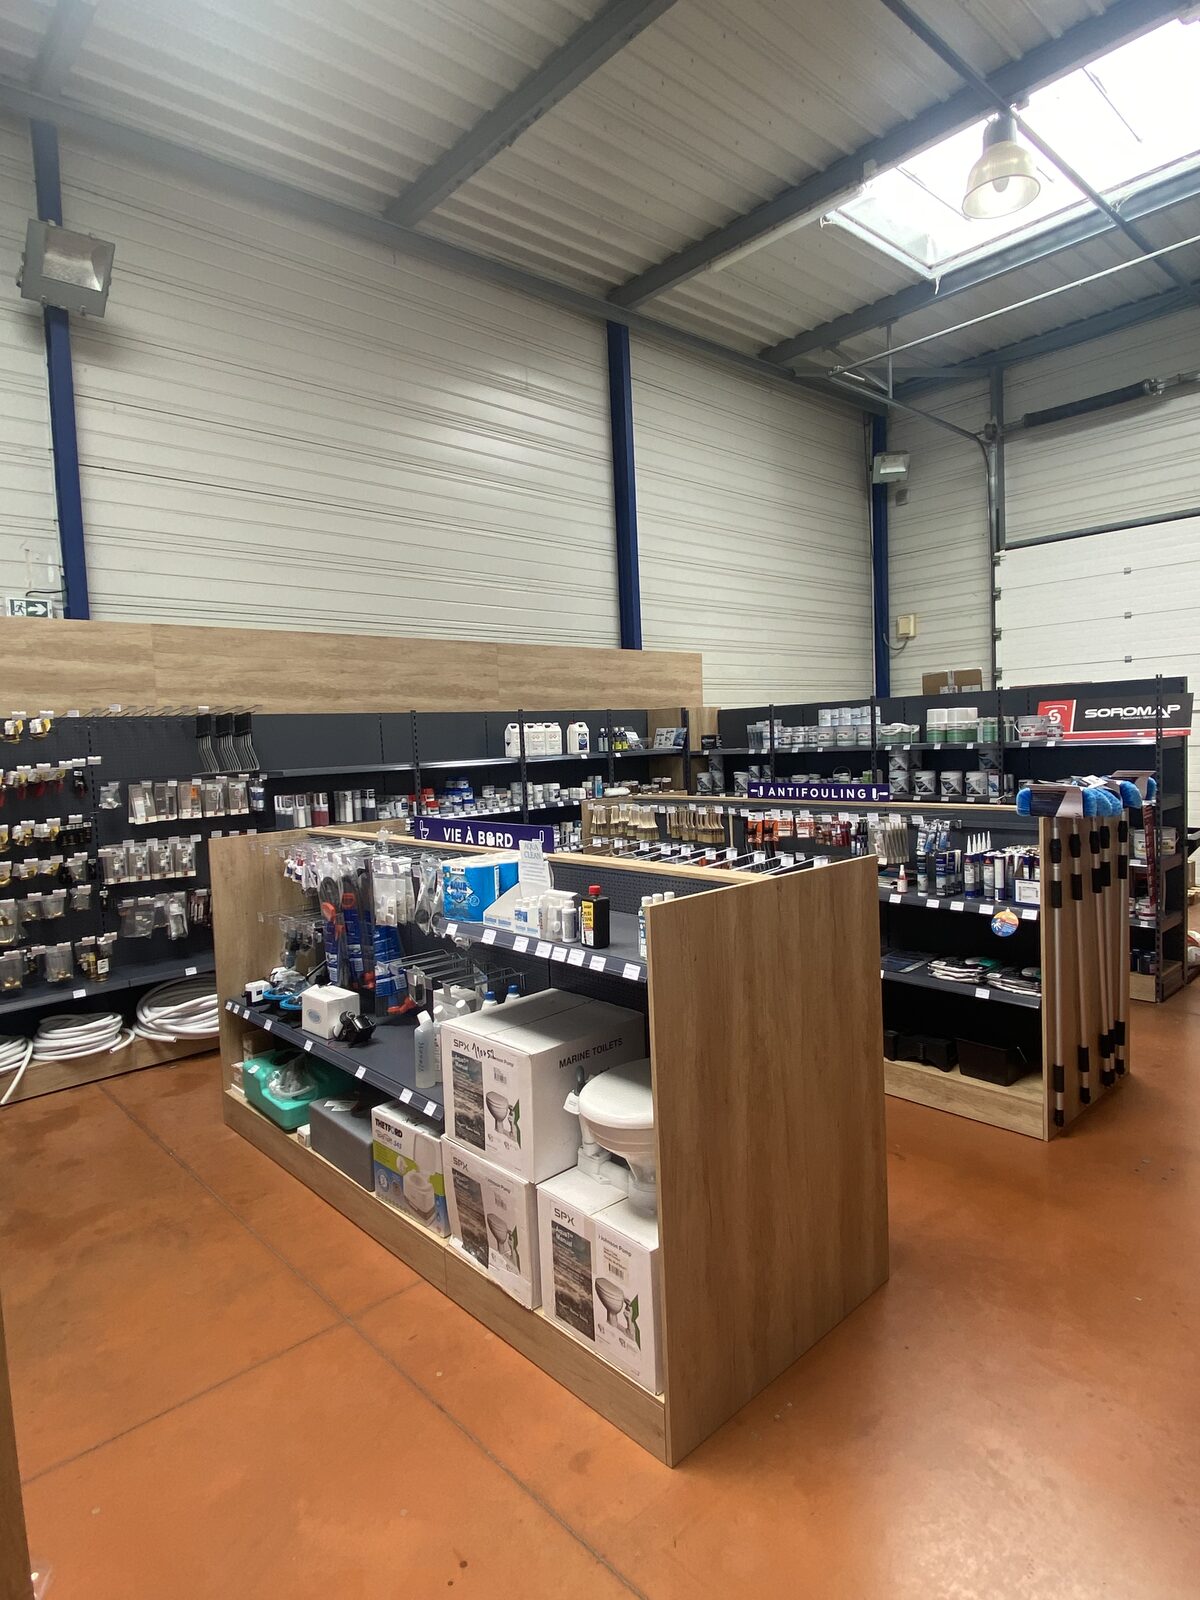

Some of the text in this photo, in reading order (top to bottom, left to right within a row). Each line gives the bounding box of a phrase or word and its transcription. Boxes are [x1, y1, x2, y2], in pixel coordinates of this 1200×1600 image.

[1085, 704, 1181, 719] SOROMAP
[768, 787, 866, 799] ANTIFOULING
[443, 827, 462, 843] VIE
[465, 825, 474, 844] À
[453, 1038, 470, 1052] SPX
[559, 1038, 624, 1069] MARINE TOILETS
[453, 1156, 469, 1172] SPX
[554, 1207, 575, 1227] SPX
